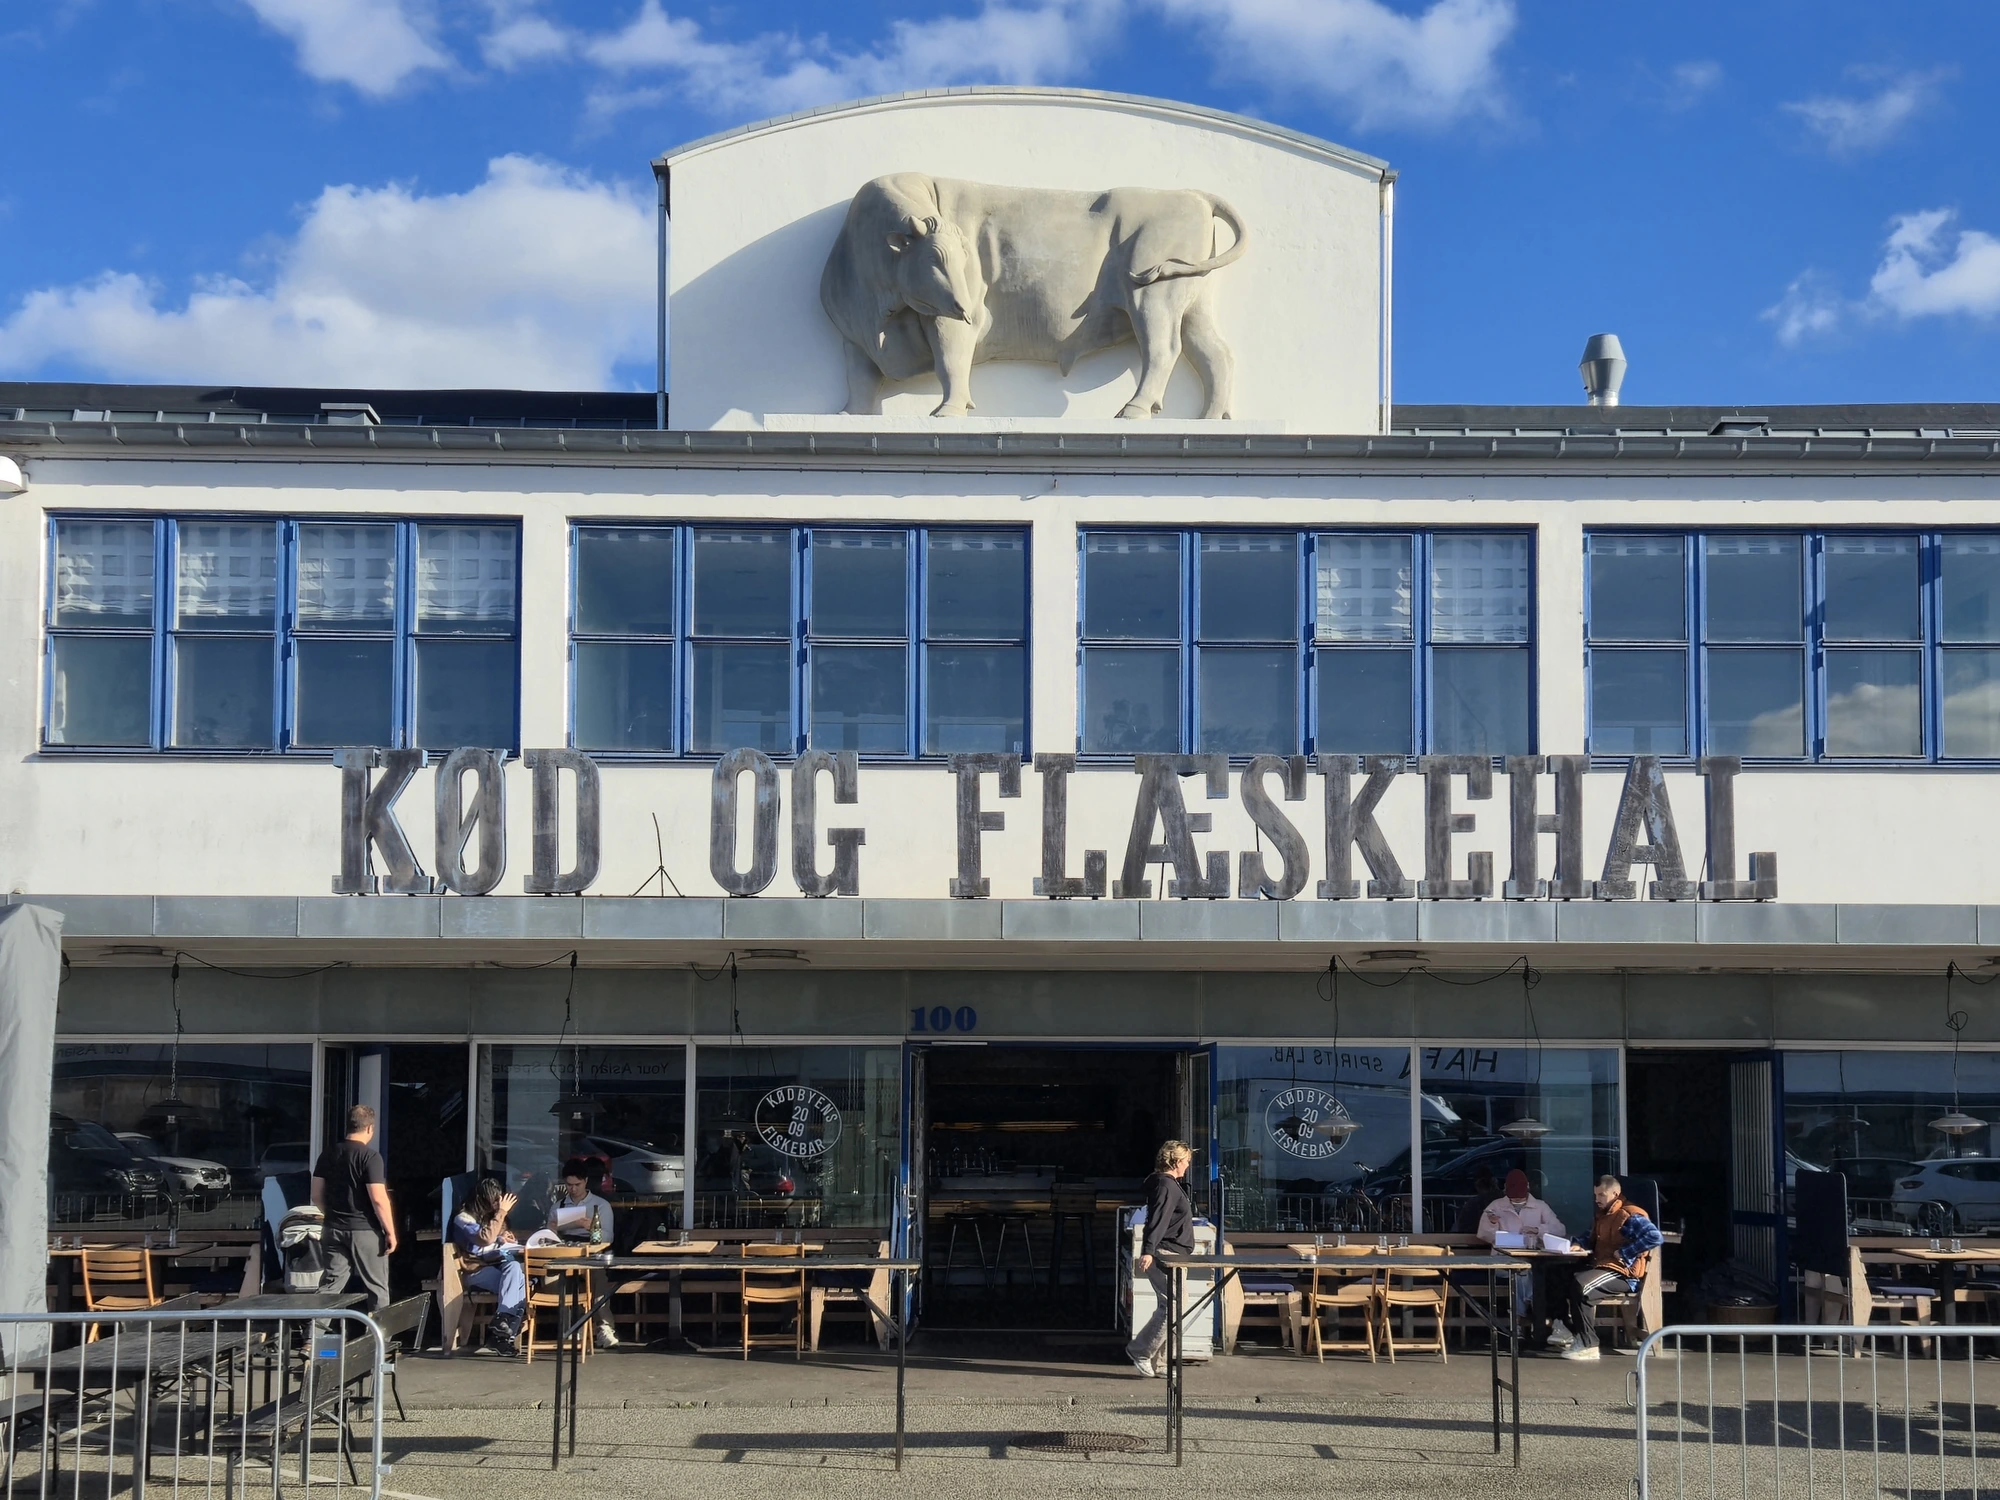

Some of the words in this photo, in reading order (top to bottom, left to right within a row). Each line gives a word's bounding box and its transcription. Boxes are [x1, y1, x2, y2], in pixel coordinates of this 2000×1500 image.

[331, 747, 602, 896] KØD
[709, 747, 866, 898] OG
[947, 753, 1778, 902] FLÆSKEHAL
[910, 1006, 977, 1032] 100
[766, 1088, 838, 1123] KØDBYENS
[792, 1105, 809, 1122] 20
[1275, 1089, 1348, 1121] KØDBYEN
[1301, 1107, 1319, 1124] 20
[762, 1126, 826, 1155] FISKEBAR
[788, 1121, 805, 1137] 09
[1272, 1127, 1336, 1157] FISKEBAR
